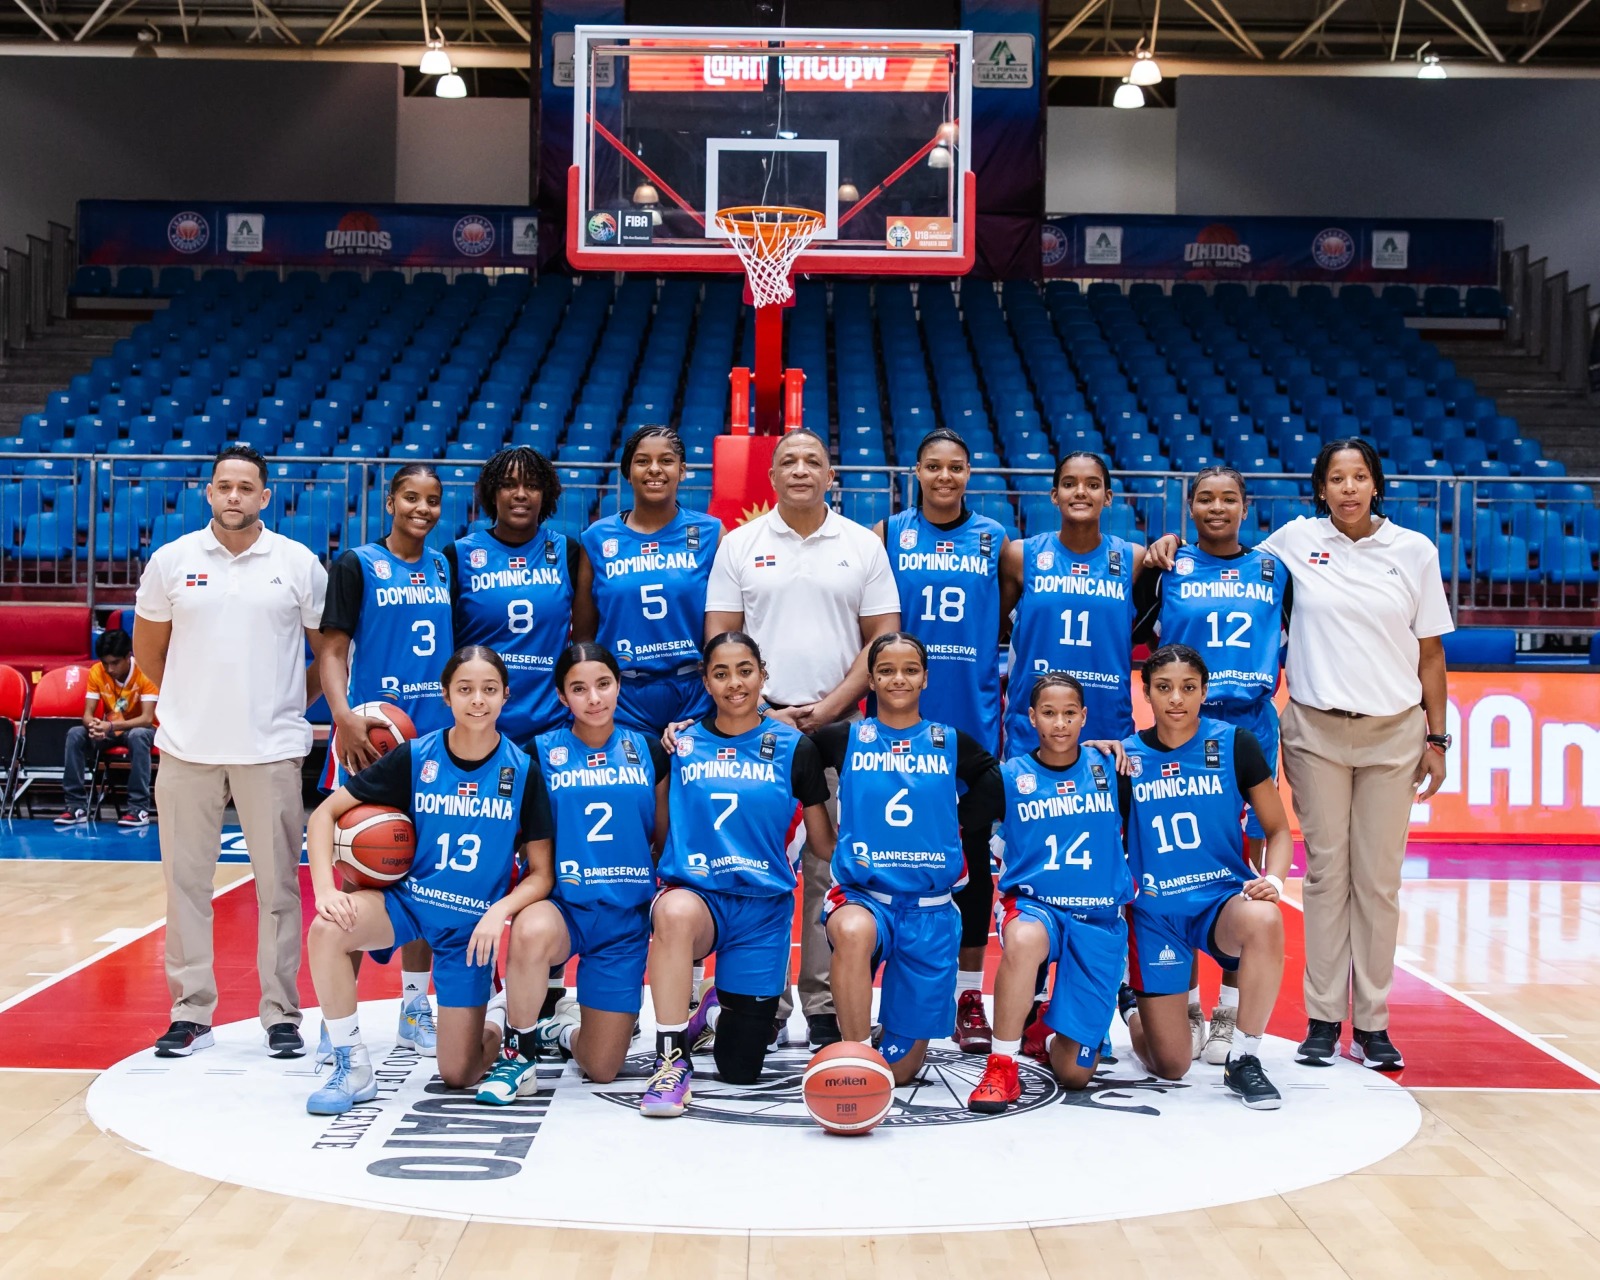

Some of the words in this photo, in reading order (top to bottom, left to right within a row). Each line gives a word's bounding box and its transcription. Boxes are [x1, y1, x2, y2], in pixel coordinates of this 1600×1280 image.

[625, 215, 649, 228] FIBA
[325, 230, 392, 251] UNIDOS
[914, 231, 929, 240] U18
[1184, 243, 1252, 263] UNIDOS
[605, 552, 698, 579] DOMINICANA
[899, 552, 988, 576] DOMINICANA
[471, 567, 561, 592] DOMINICANA
[1034, 574, 1124, 600] DOMINICANA
[641, 584, 667, 619] 5
[921, 586, 965, 622] 18
[1181, 582, 1273, 604] DOMINICANA
[508, 599, 533, 633] 8
[1060, 610, 1091, 646] 11
[412, 620, 435, 656] 3
[1207, 612, 1252, 648] 12
[497, 653, 554, 665] NRESERVAS
[635, 639, 695, 655] BANRESERV
[926, 644, 977, 656] NRESERVA
[403, 681, 443, 694] BANRES
[852, 752, 949, 774] DOMINICANA
[1408, 691, 1600, 823] Am
[551, 765, 648, 791] DOMINICANA
[681, 760, 775, 785] DOMINICANA
[415, 792, 512, 820] DOMINICANA
[711, 793, 738, 830] 7
[885, 789, 913, 826] 6
[1018, 793, 1114, 821] DOMINICANA
[585, 802, 613, 841] 2
[1152, 812, 1201, 853] 10
[394, 833, 409, 842] FIBA
[435, 833, 481, 872] 13
[872, 851, 945, 861] BANRESERVAS
[1044, 832, 1092, 870] 14
[584, 866, 649, 877] BANRESERVAS
[1159, 867, 1232, 890] BANRESERVAS
[411, 883, 491, 910] BANRESERVAS
[825, 1076, 867, 1087] molten
[836, 1103, 857, 1113] FIBA
